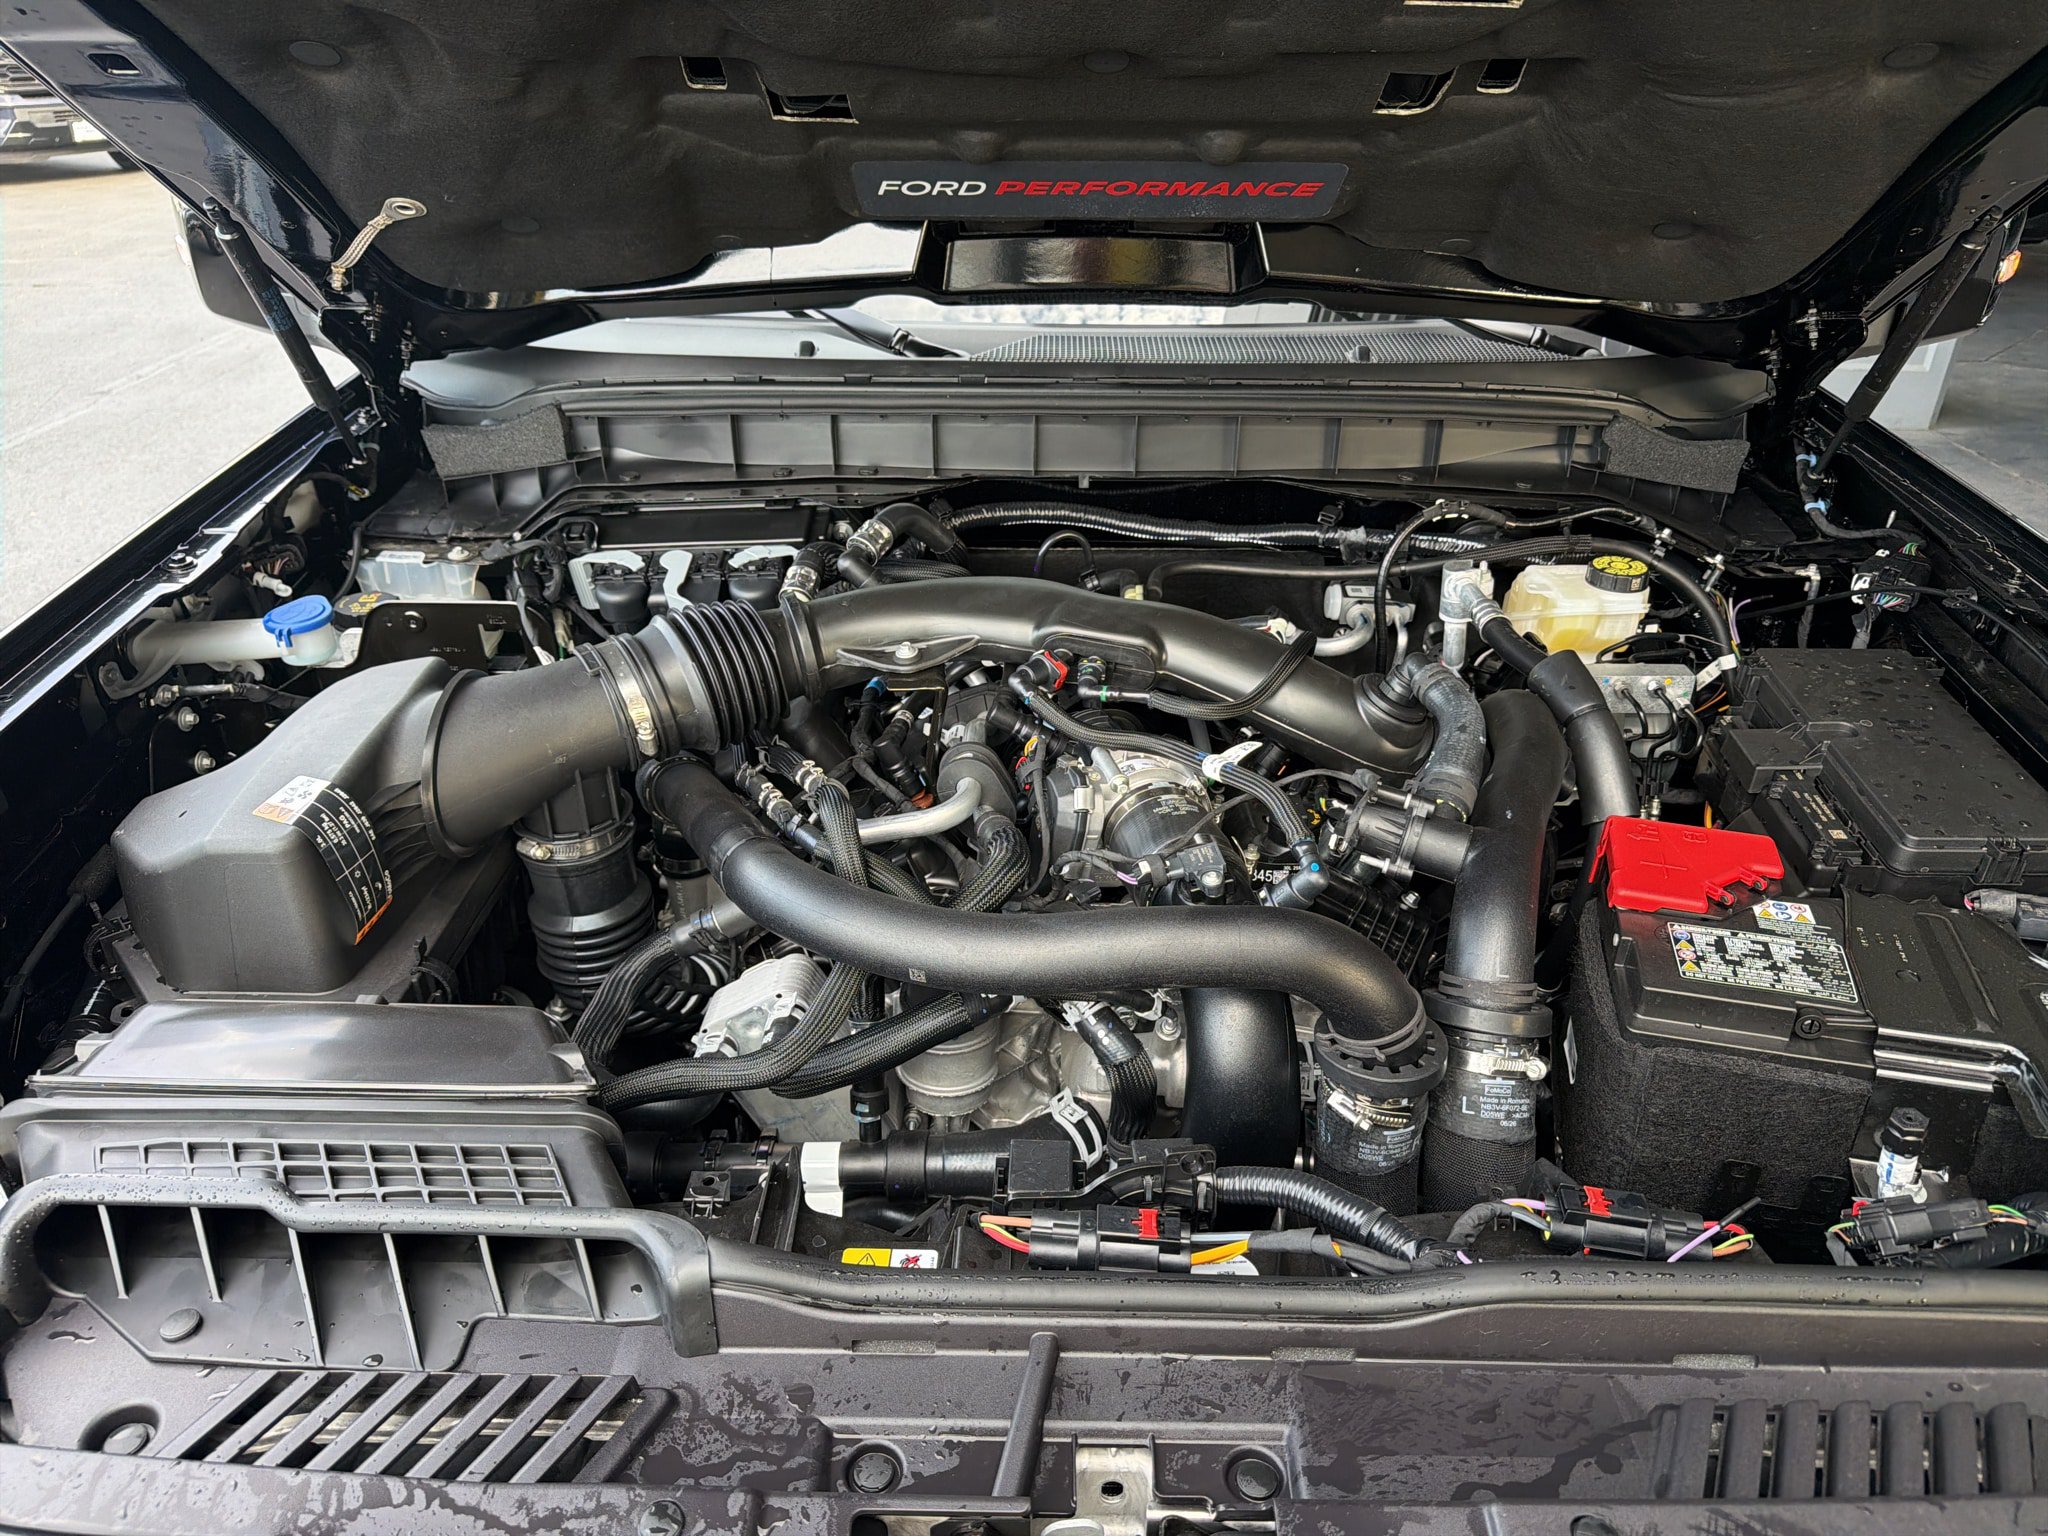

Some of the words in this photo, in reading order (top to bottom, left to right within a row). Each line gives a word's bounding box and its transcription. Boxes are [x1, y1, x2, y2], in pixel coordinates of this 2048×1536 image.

[877, 180, 987, 197] FORD
[994, 180, 1326, 198] PERFORMANCE
[339, 815, 351, 828] PAG
[1486, 1086, 1511, 1094] FoMoCo
[1462, 1096, 1475, 1114] L
